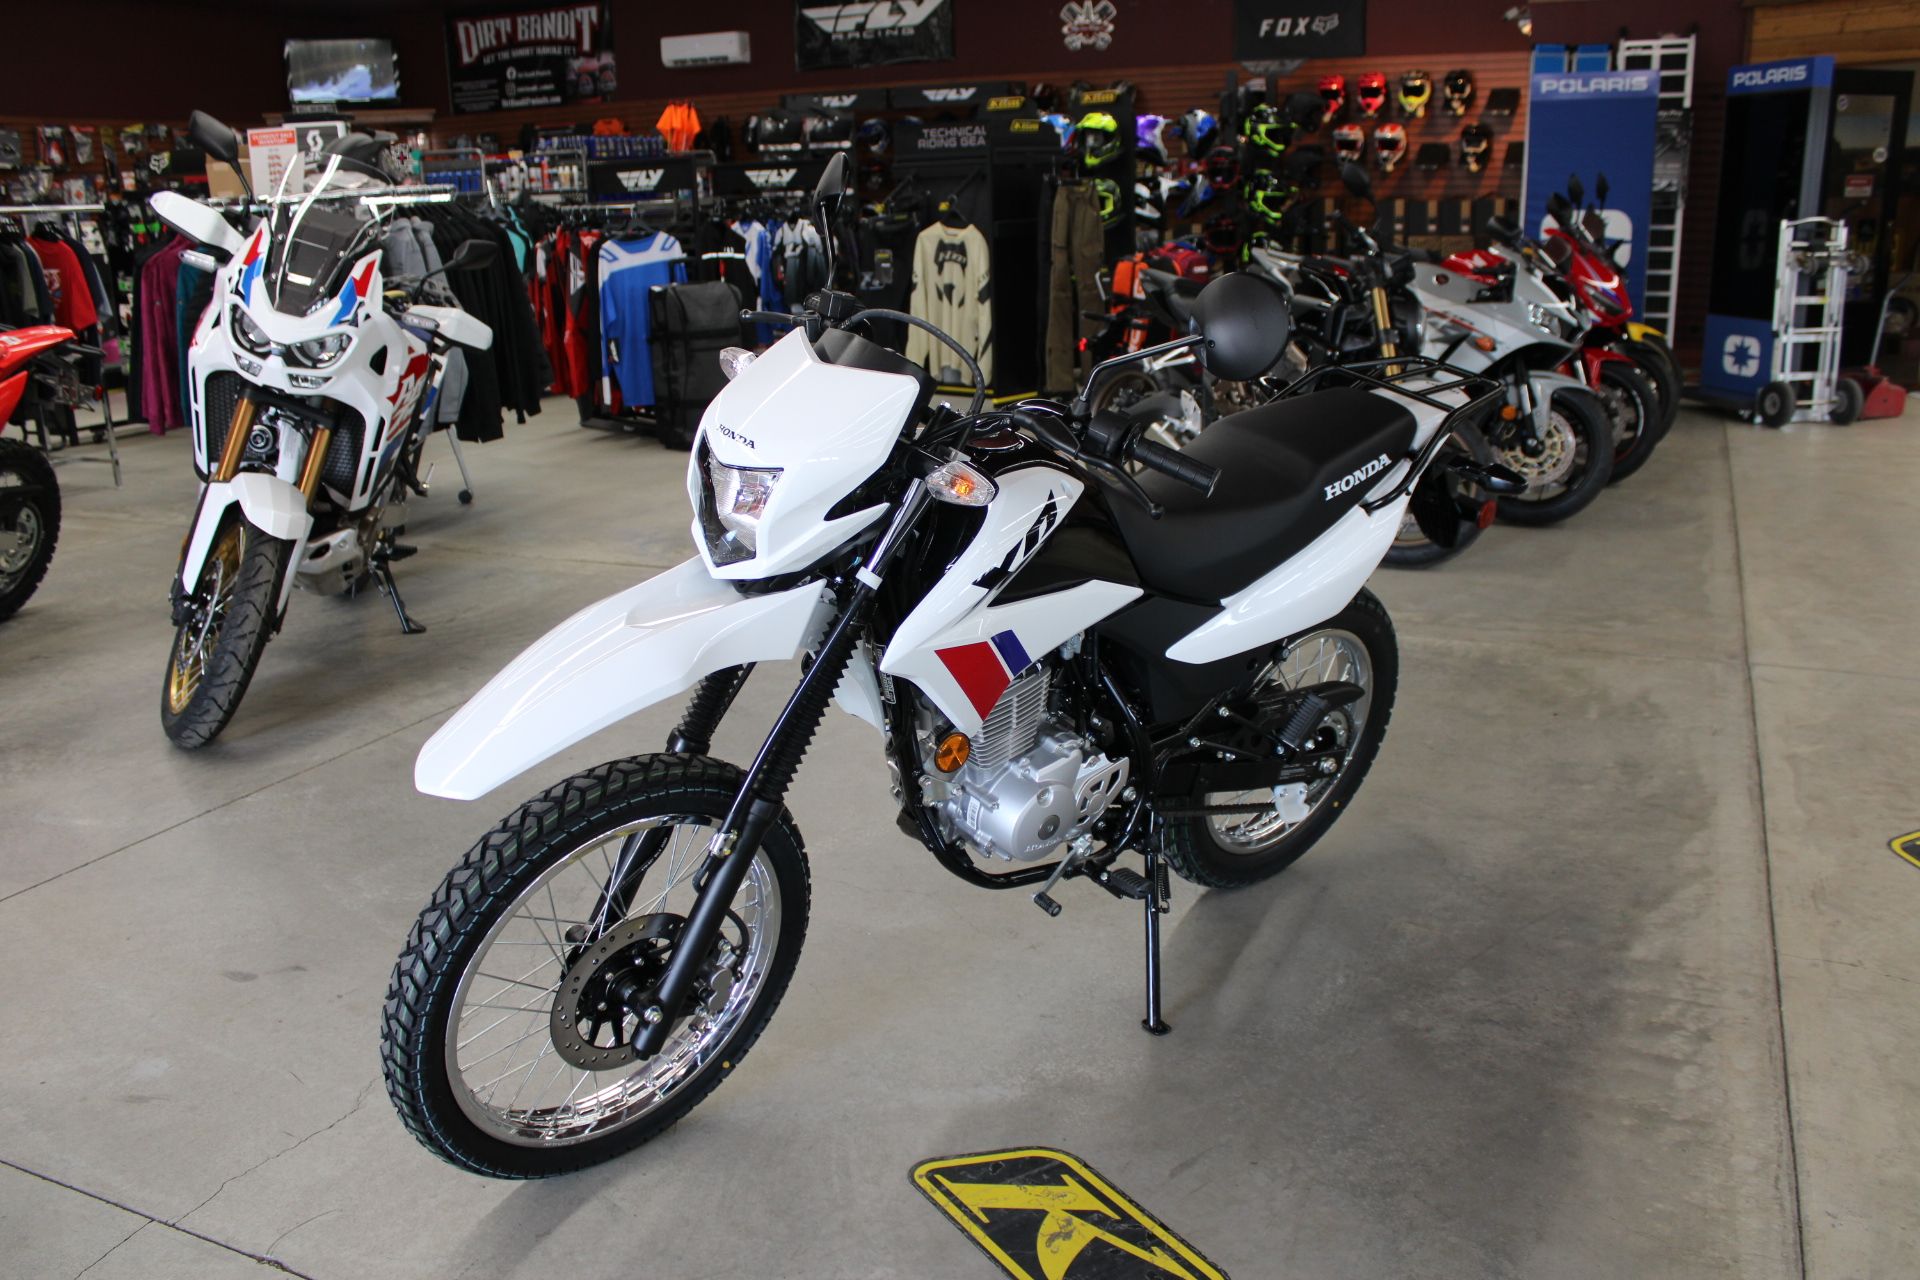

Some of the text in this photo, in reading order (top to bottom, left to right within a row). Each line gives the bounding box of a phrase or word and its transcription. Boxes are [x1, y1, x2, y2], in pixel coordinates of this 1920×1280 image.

[801, 0, 945, 33] FLY
[457, 6, 598, 64] DIRT BANDIT
[831, 27, 915, 41] RACING
[1259, 17, 1310, 38] FOX
[1540, 76, 1649, 94] POLARIS
[1732, 64, 1808, 88] POLARIS
[922, 87, 977, 101] FLY
[922, 125, 987, 139] TECHNICAL
[918, 137, 958, 149] RIDING
[616, 168, 665, 188] FLY
[744, 168, 797, 187] FLY
[1324, 453, 1393, 501] HONDA
